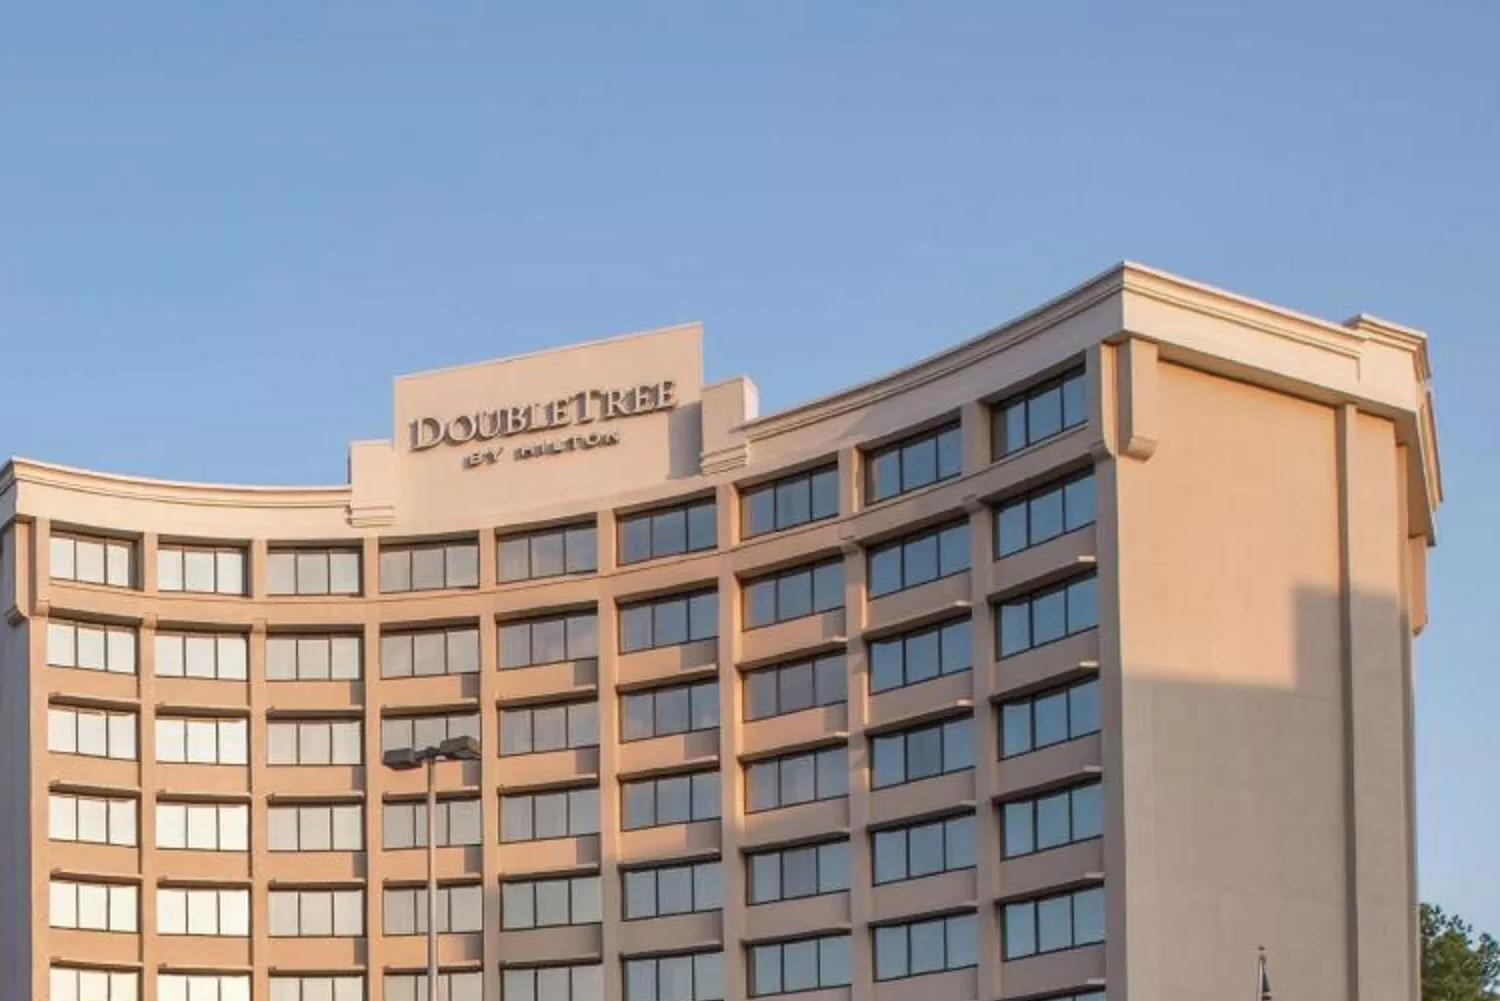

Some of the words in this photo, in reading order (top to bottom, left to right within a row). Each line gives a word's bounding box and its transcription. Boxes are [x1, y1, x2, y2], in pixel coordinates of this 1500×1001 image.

[408, 380, 676, 451] DOUBLETREE
[464, 447, 503, 470] BY
[514, 432, 620, 461] HILTON
